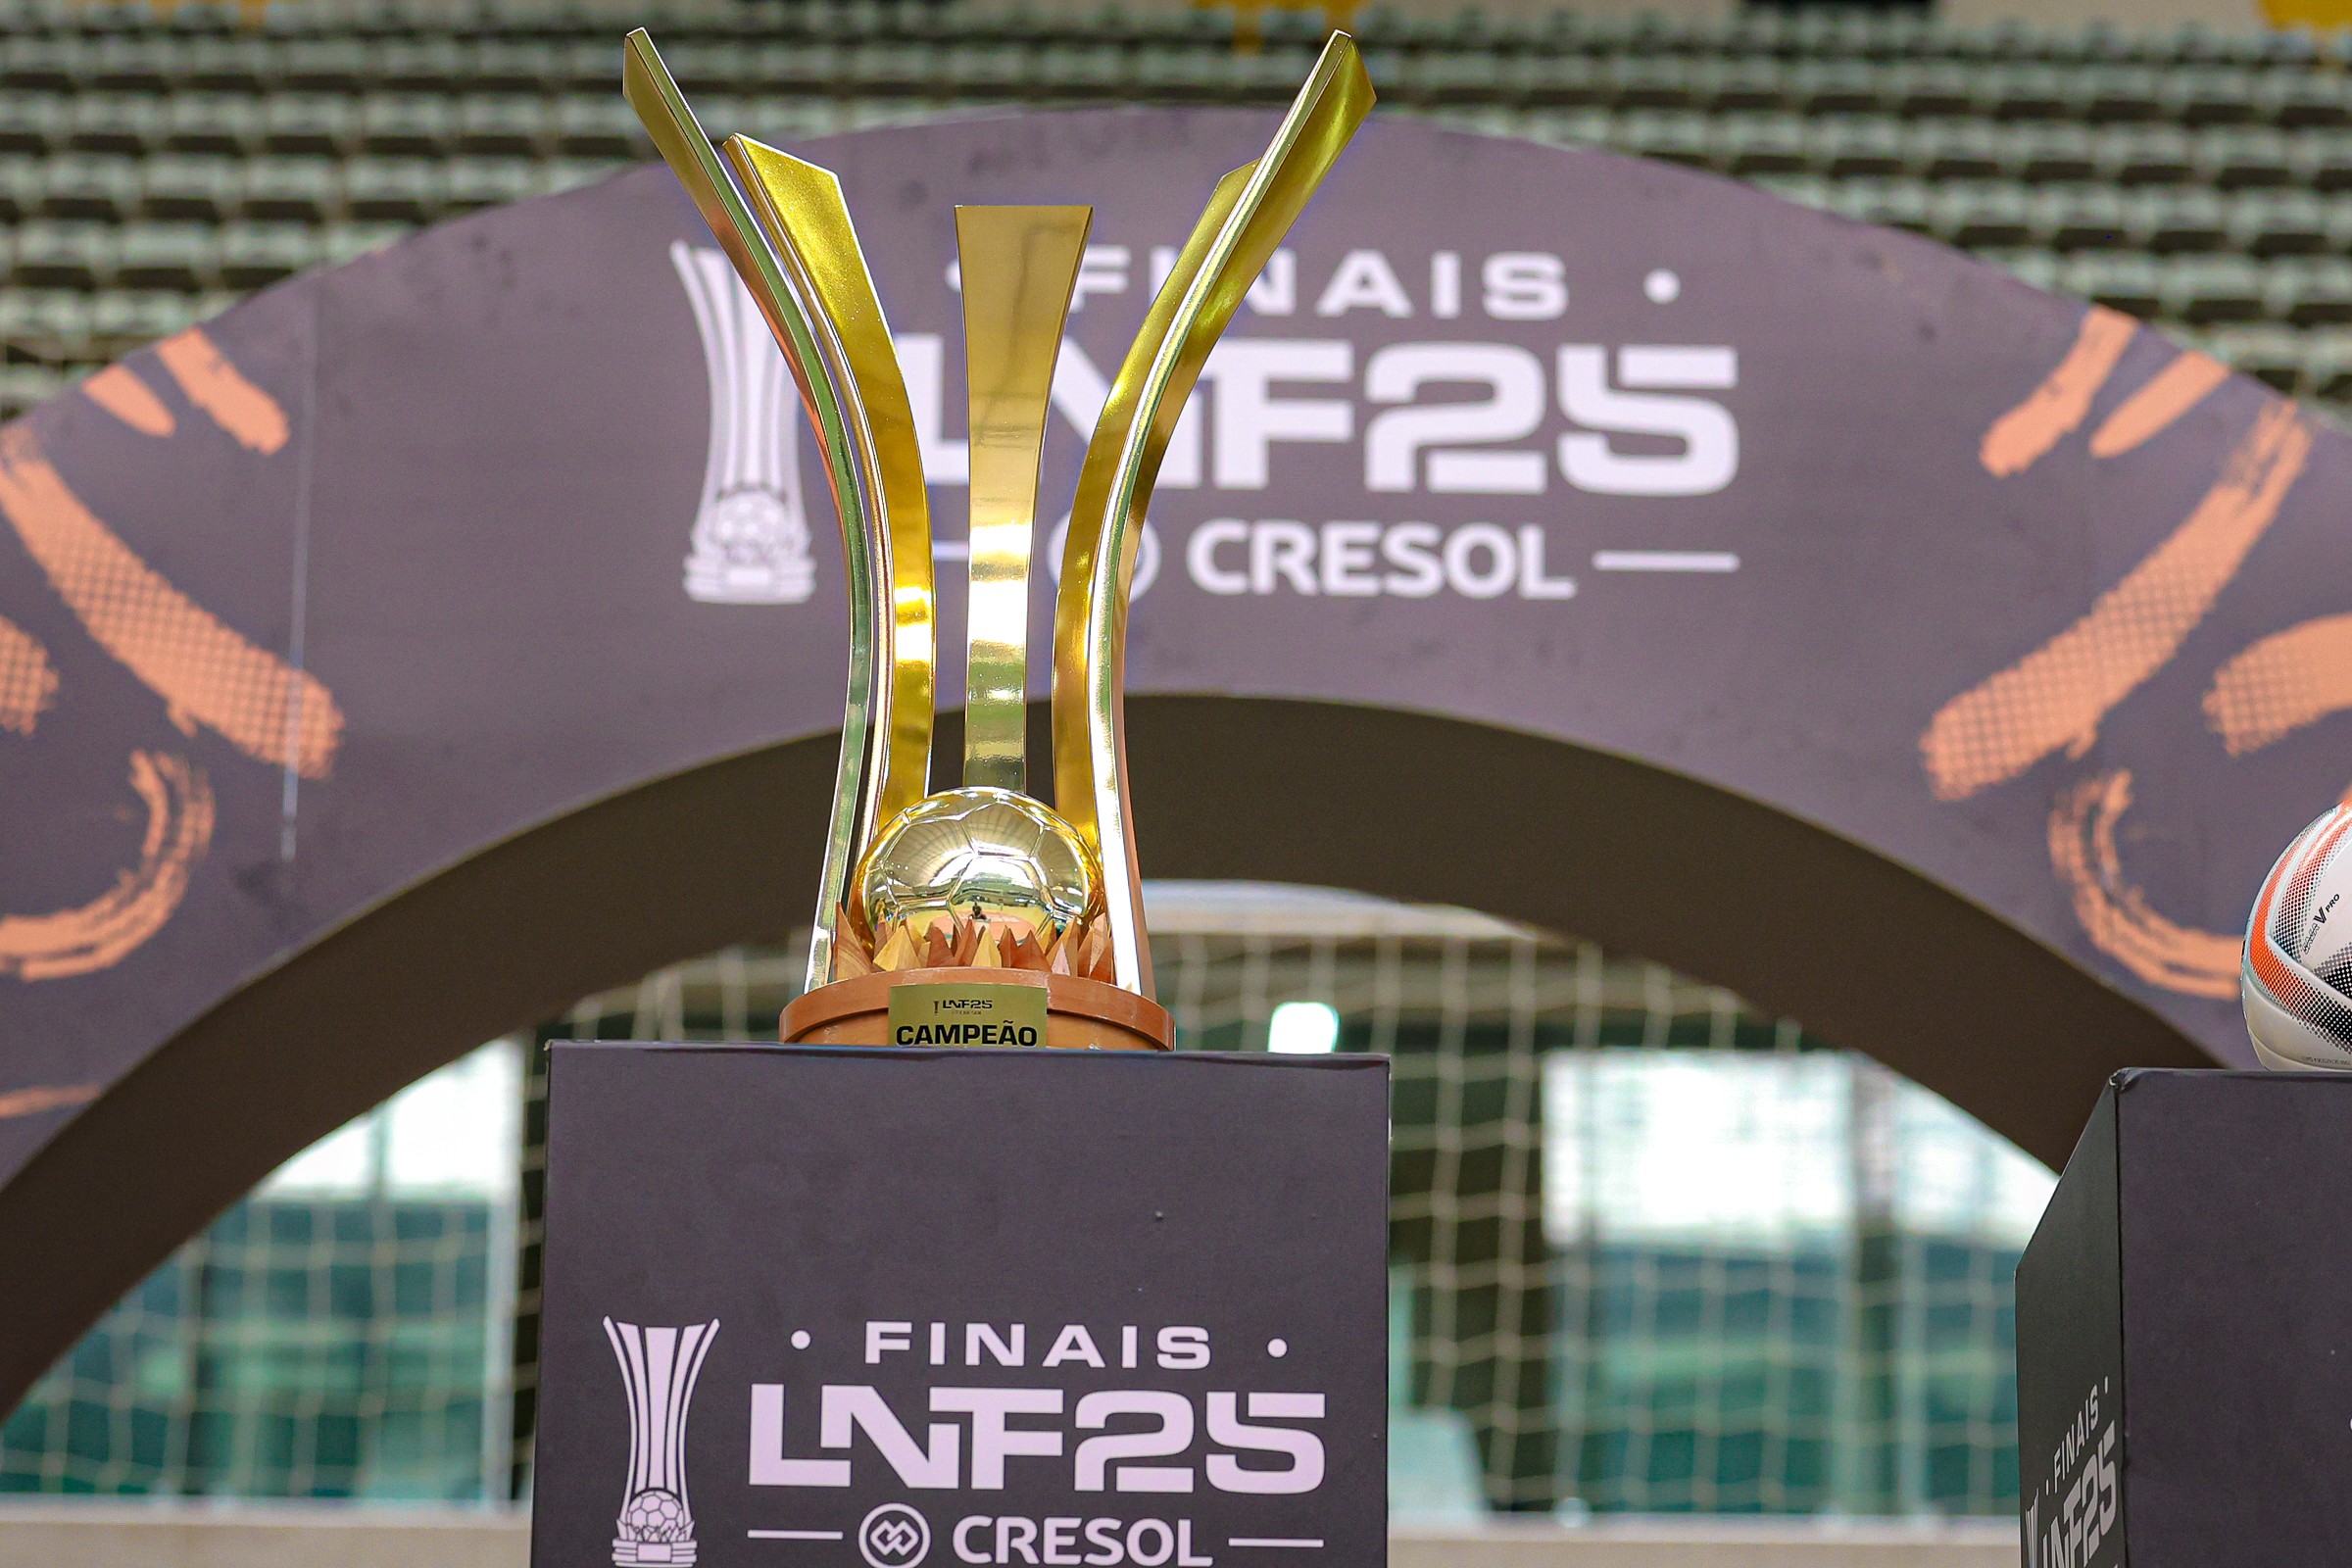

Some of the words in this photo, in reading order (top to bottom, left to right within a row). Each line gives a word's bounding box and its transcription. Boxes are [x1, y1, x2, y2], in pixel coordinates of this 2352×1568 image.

[1187, 519, 1577, 599] CRESOL
[2326, 894, 2339, 912] PRO
[942, 1000, 993, 1009] LNF25
[896, 1020, 1038, 1048] CAMPEÃO
[864, 1321, 1211, 1370] FINAIS
[749, 1383, 1325, 1494] LNF25
[2054, 1384, 2099, 1494] FINAIS
[953, 1515, 1213, 1567] CRESOL
